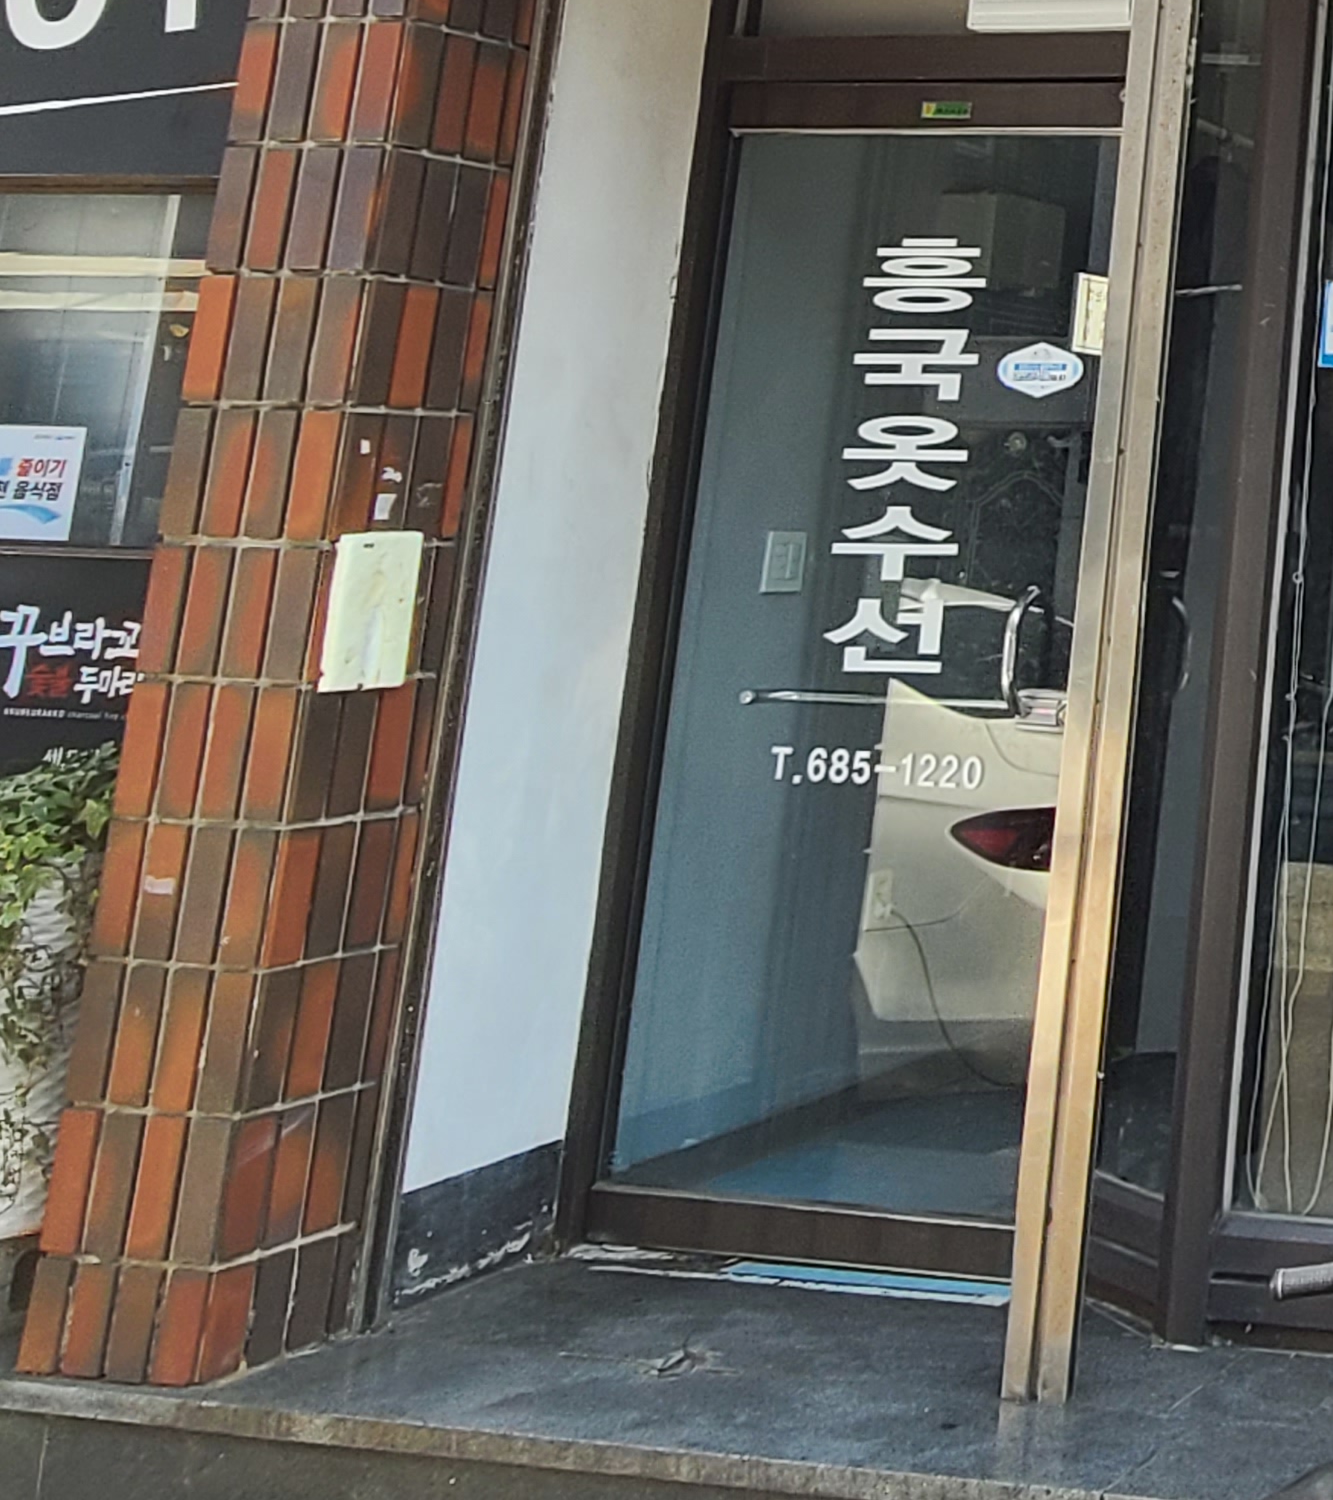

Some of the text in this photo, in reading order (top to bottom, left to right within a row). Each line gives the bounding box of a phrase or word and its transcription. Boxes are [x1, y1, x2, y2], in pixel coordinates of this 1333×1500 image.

[822, 237, 986, 674] 흥국옷수선
[13, 480, 63, 501] 음식점
[770, 745, 982, 790] T.685-1220
